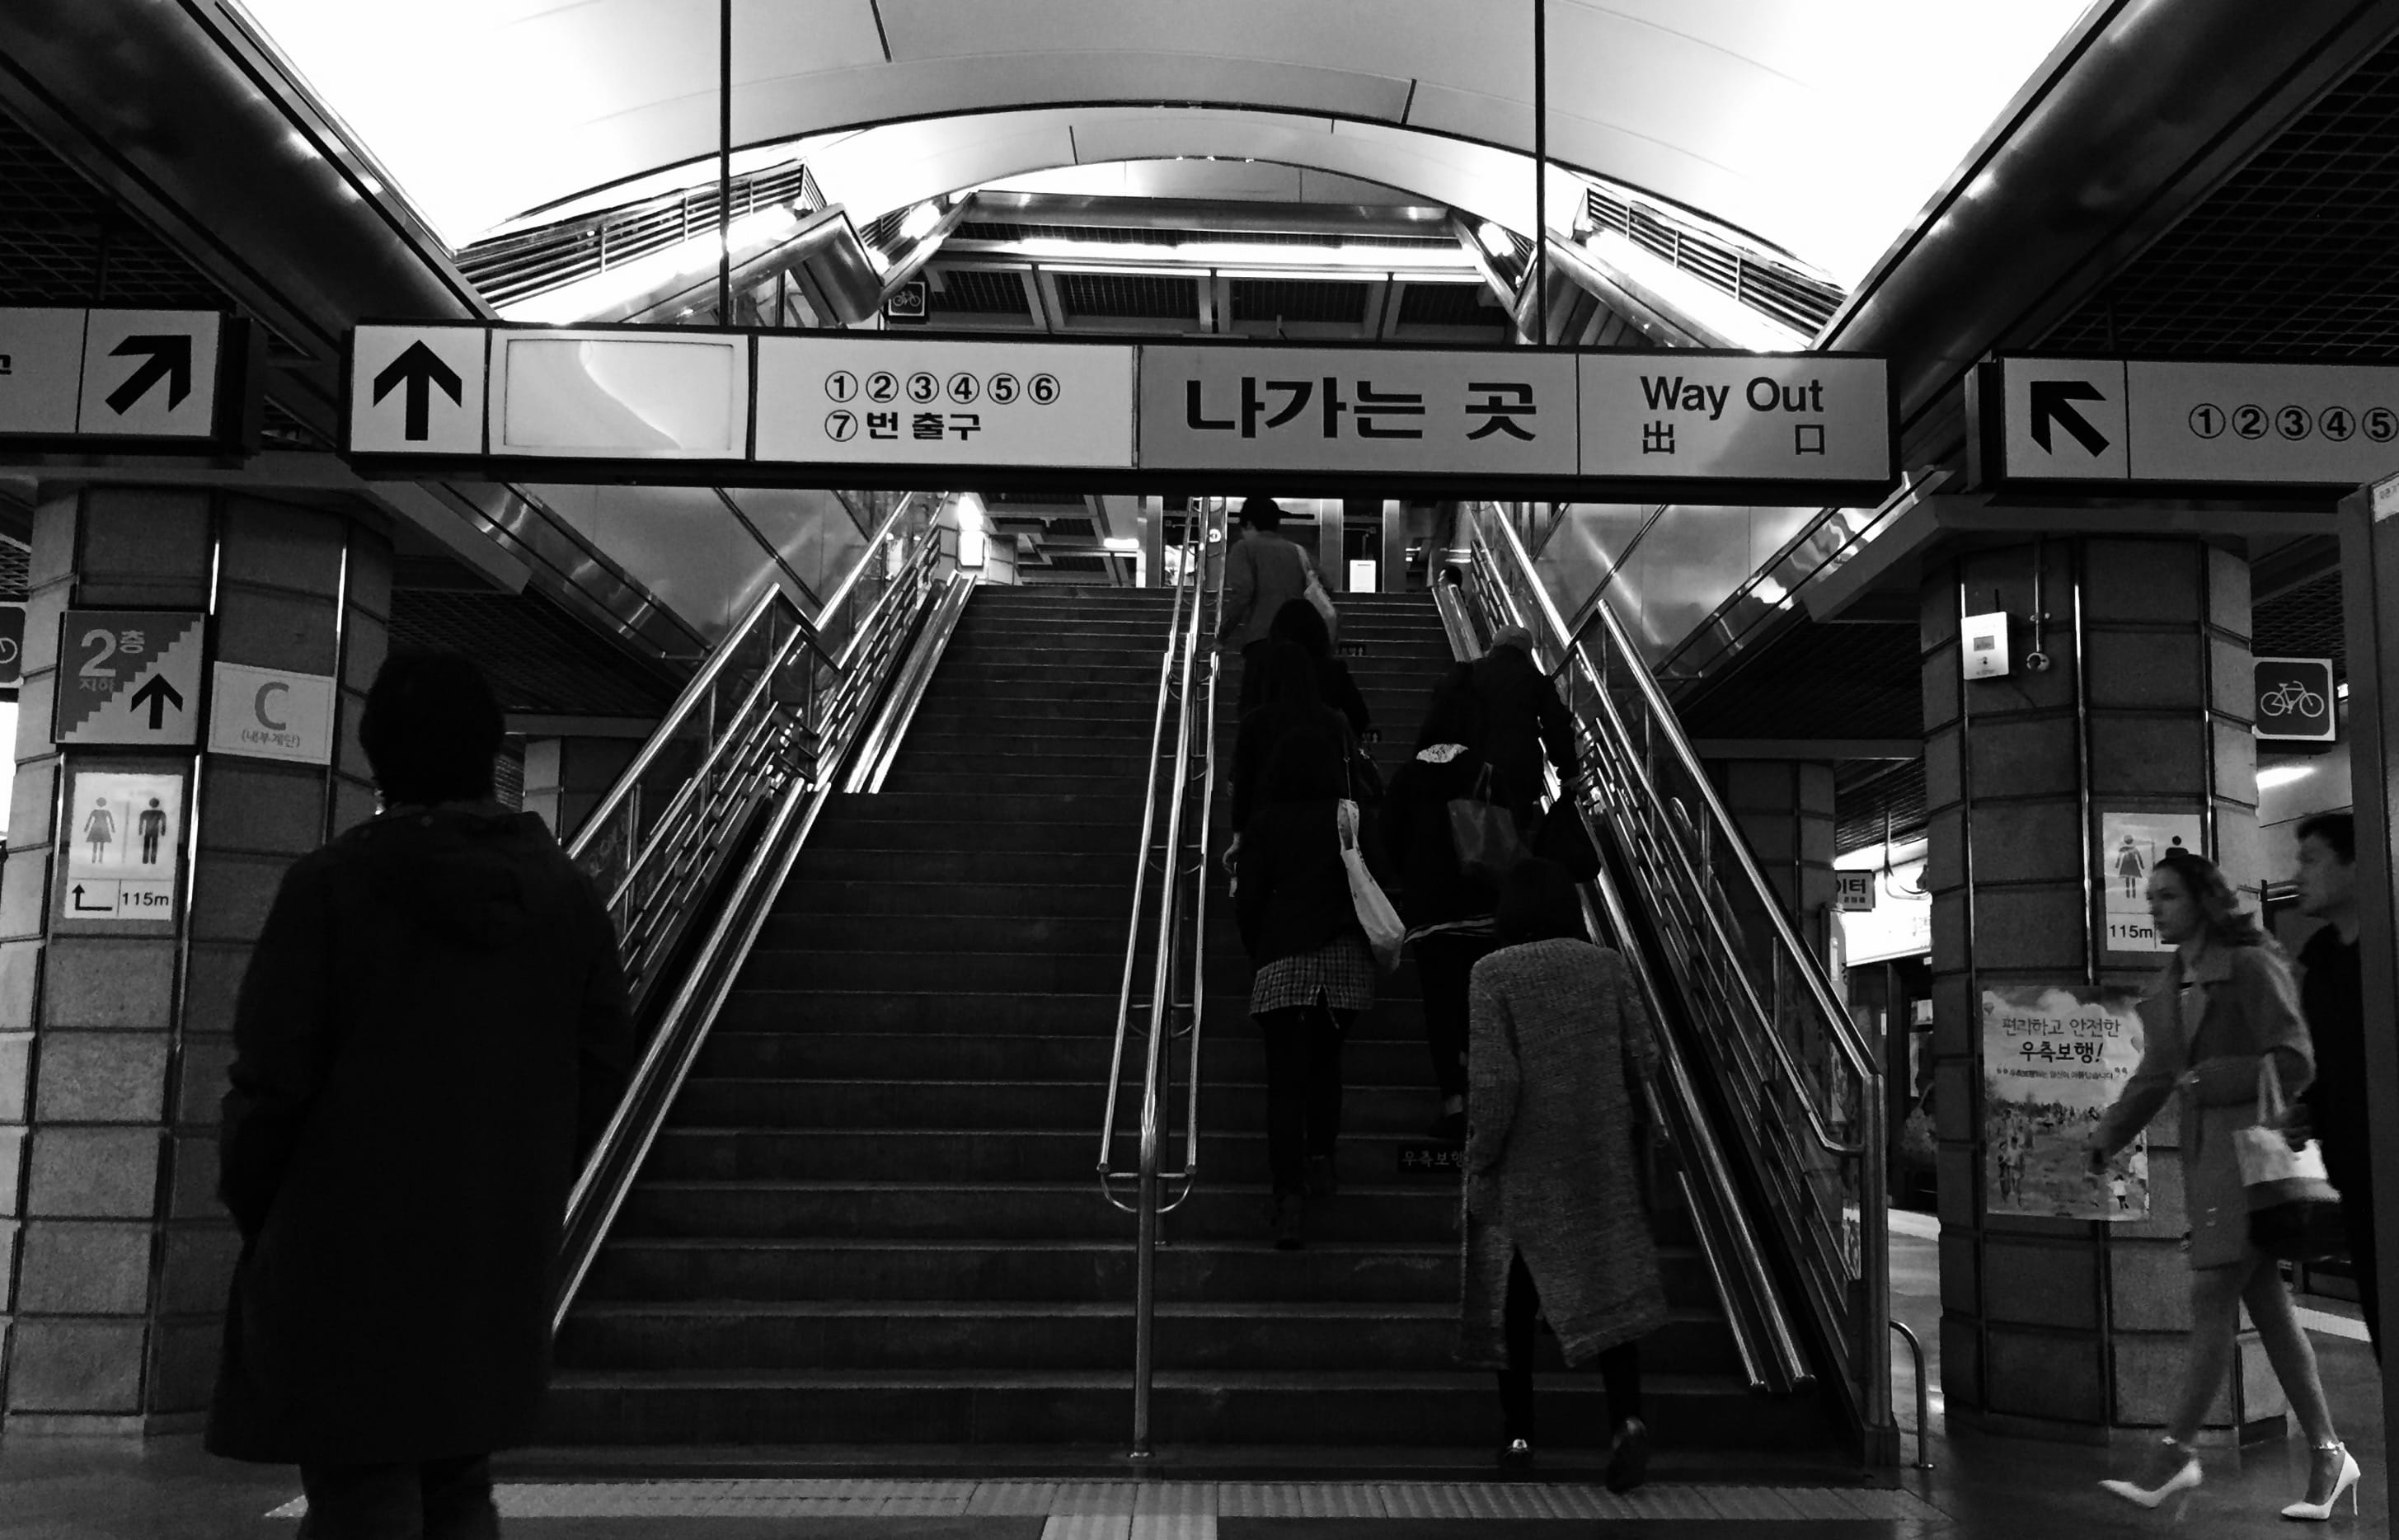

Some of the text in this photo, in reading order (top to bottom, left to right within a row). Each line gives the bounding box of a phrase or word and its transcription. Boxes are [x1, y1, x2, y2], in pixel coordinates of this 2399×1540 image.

[1186, 377, 1537, 441] 나가는 곳
[1640, 376, 1824, 420] Way Out
[912, 412, 981, 440] 출구
[254, 681, 289, 731] C
[122, 892, 169, 906] 115m
[2110, 925, 2153, 938] 115m
[2002, 1017, 2121, 1037] 편리하고 안전한
[2020, 1041, 2104, 1063] 우측보행!
